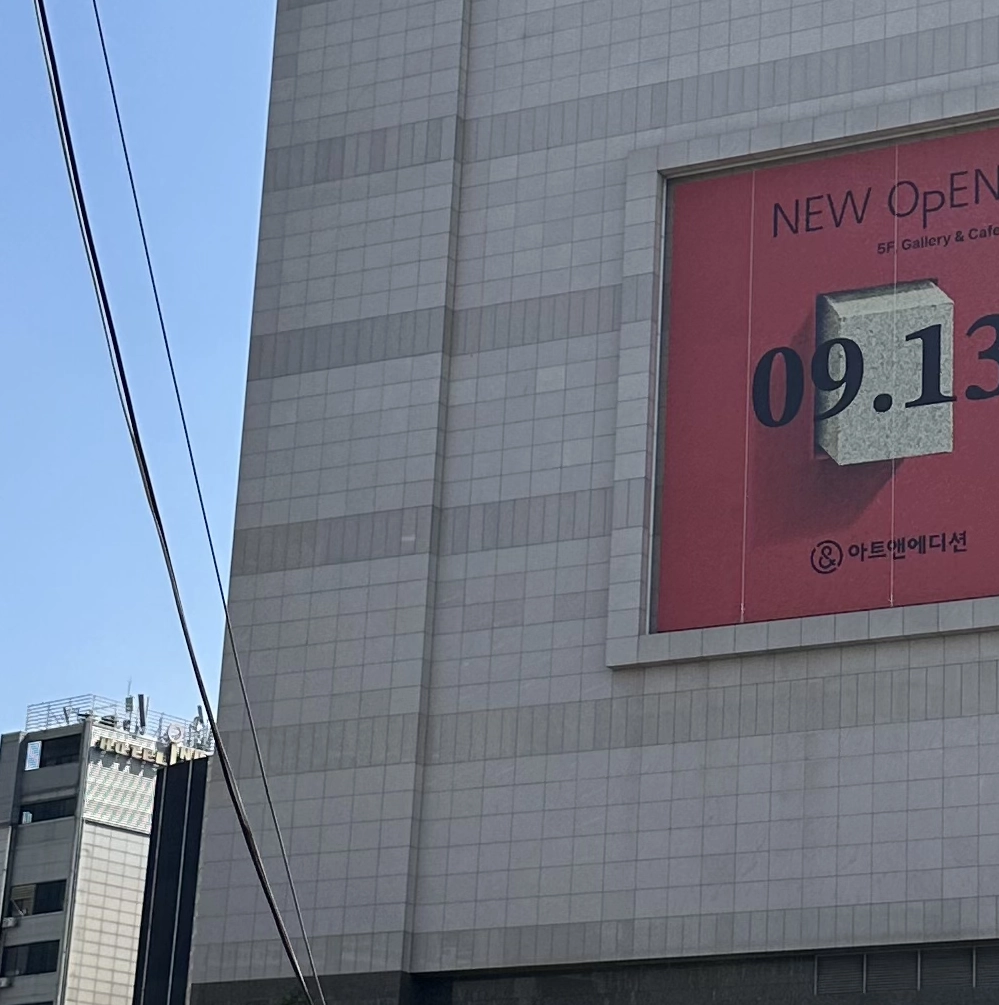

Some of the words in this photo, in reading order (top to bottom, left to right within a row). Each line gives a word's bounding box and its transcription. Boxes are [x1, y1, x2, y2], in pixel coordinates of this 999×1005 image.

[773, 187, 872, 238] NEW
[901, 234, 951, 251] Gallery
[954, 230, 965, 243] &
[848, 530, 967, 561] 아트앤에디션
